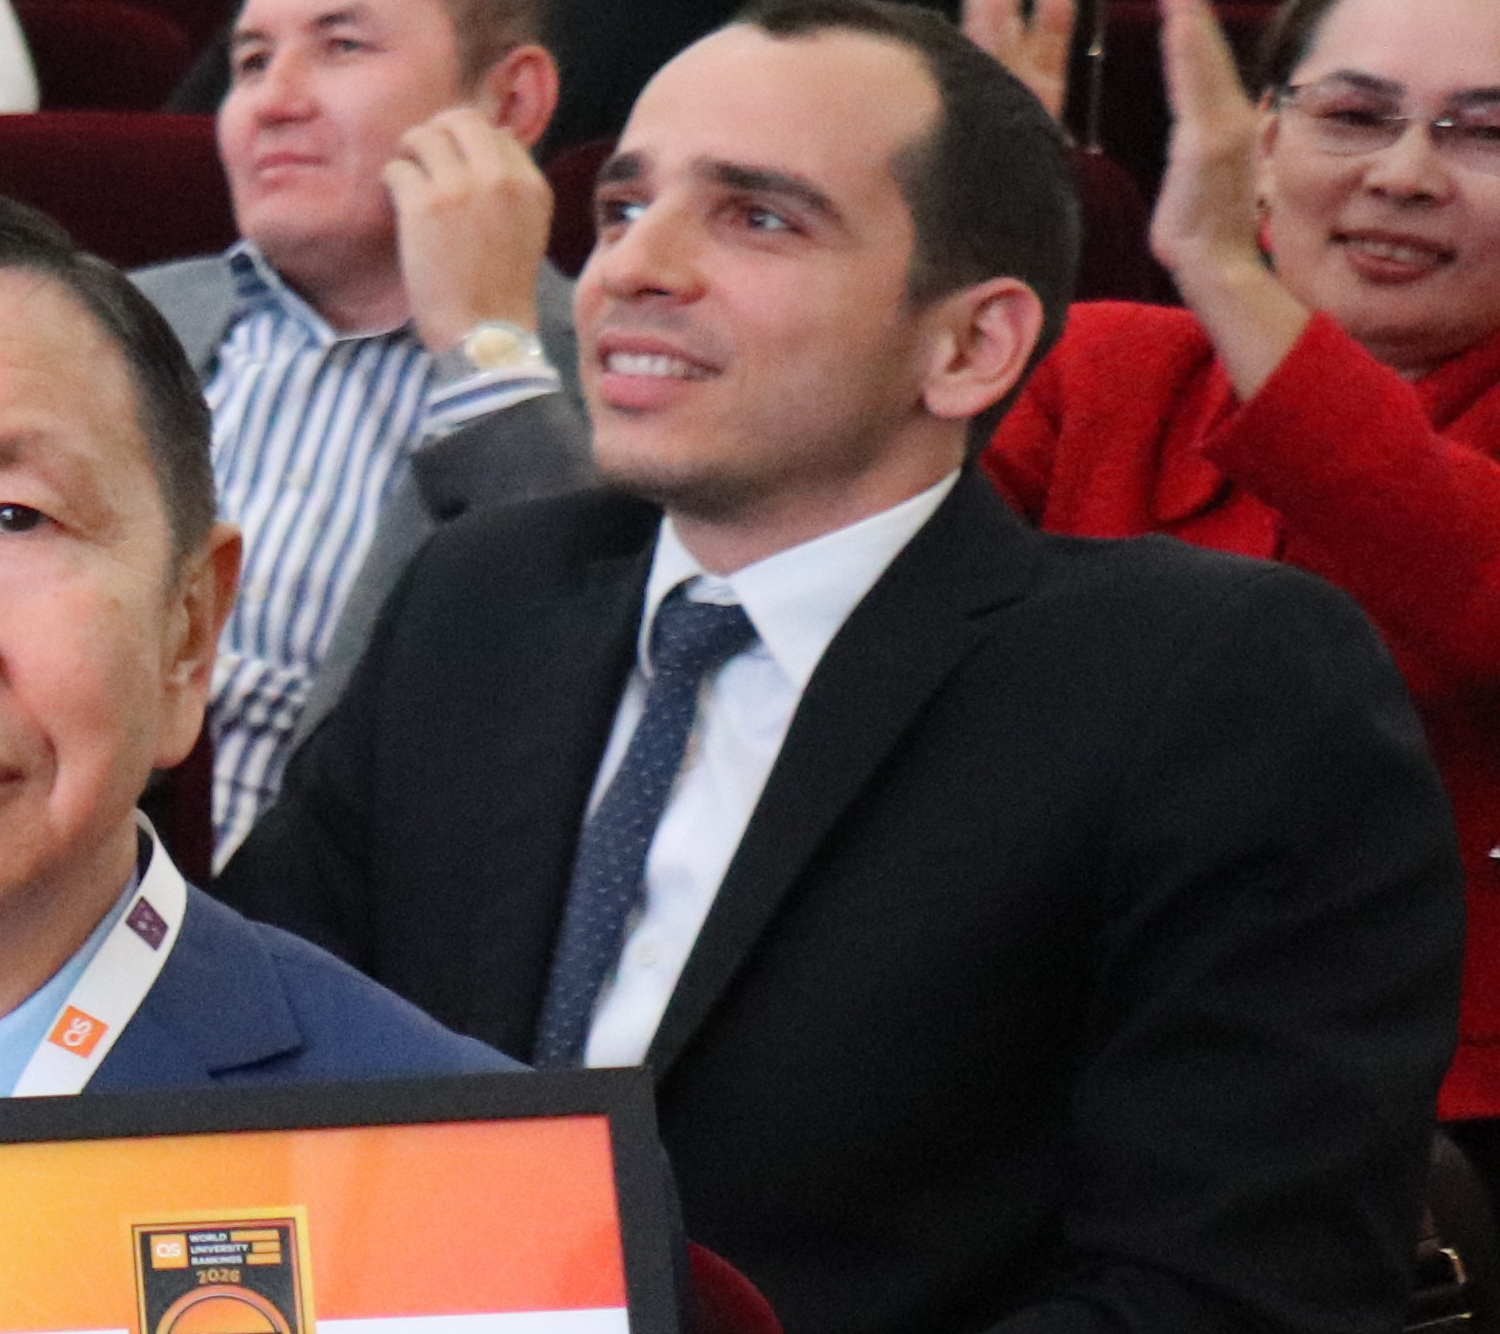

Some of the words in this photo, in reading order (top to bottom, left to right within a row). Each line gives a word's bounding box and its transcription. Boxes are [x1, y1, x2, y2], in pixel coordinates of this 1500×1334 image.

[63, 1017, 93, 1047] QS
[156, 1243, 182, 1258] QS
[196, 1270, 241, 1284] 2026
